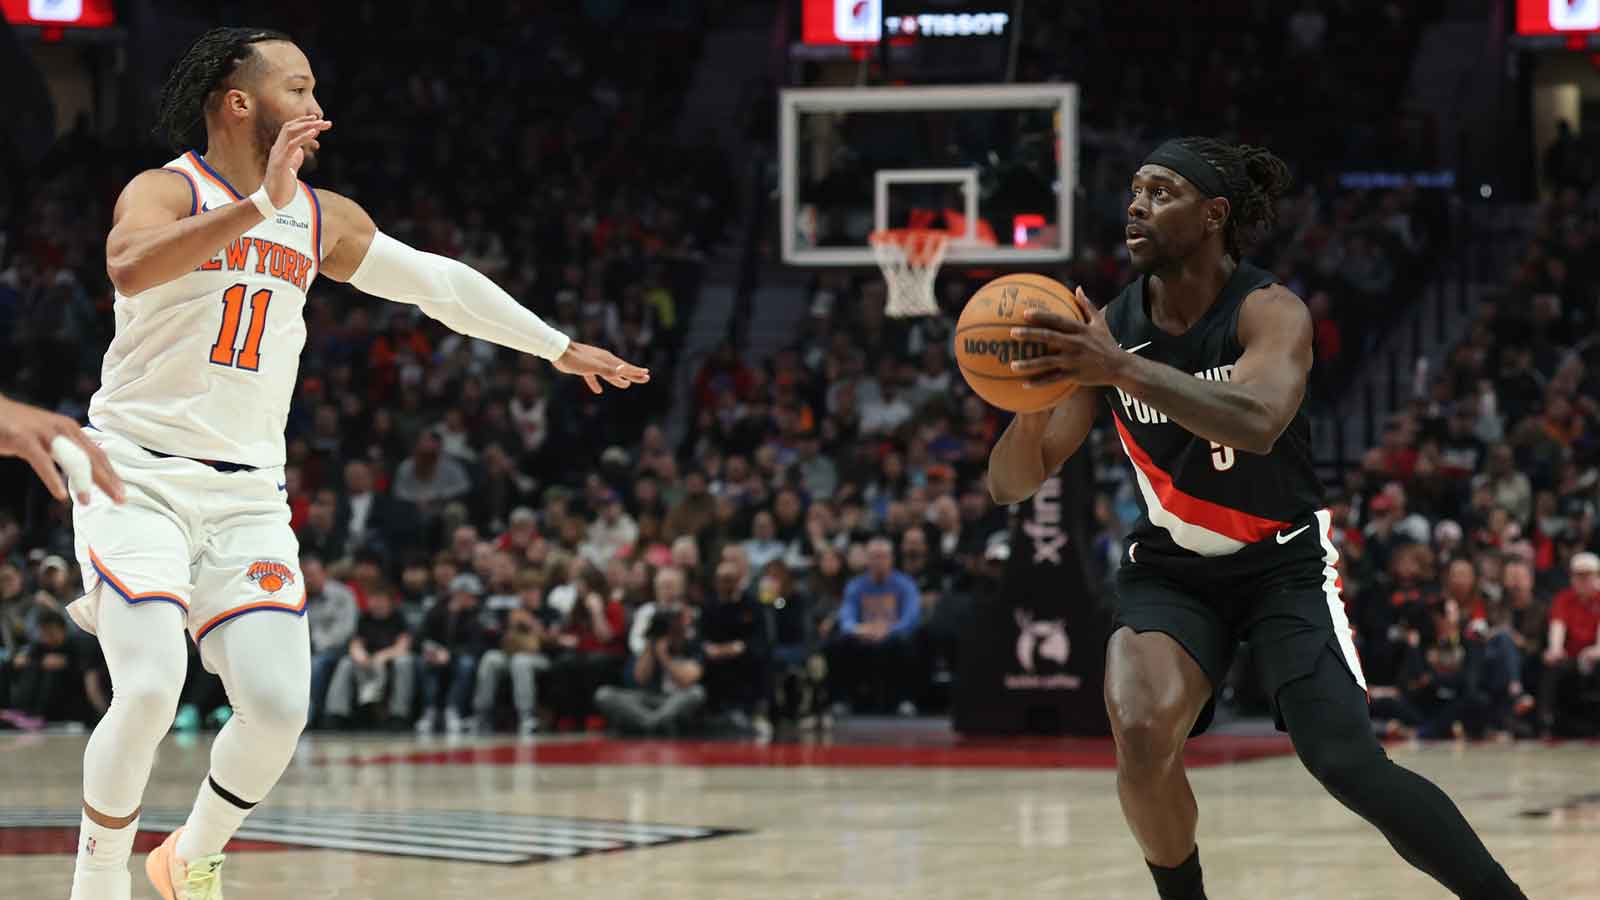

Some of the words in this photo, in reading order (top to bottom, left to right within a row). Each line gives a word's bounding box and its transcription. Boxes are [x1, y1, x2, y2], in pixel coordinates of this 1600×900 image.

[918, 13, 1008, 36] TISSOT
[254, 238, 312, 290] YORK
[209, 283, 273, 372] 11
